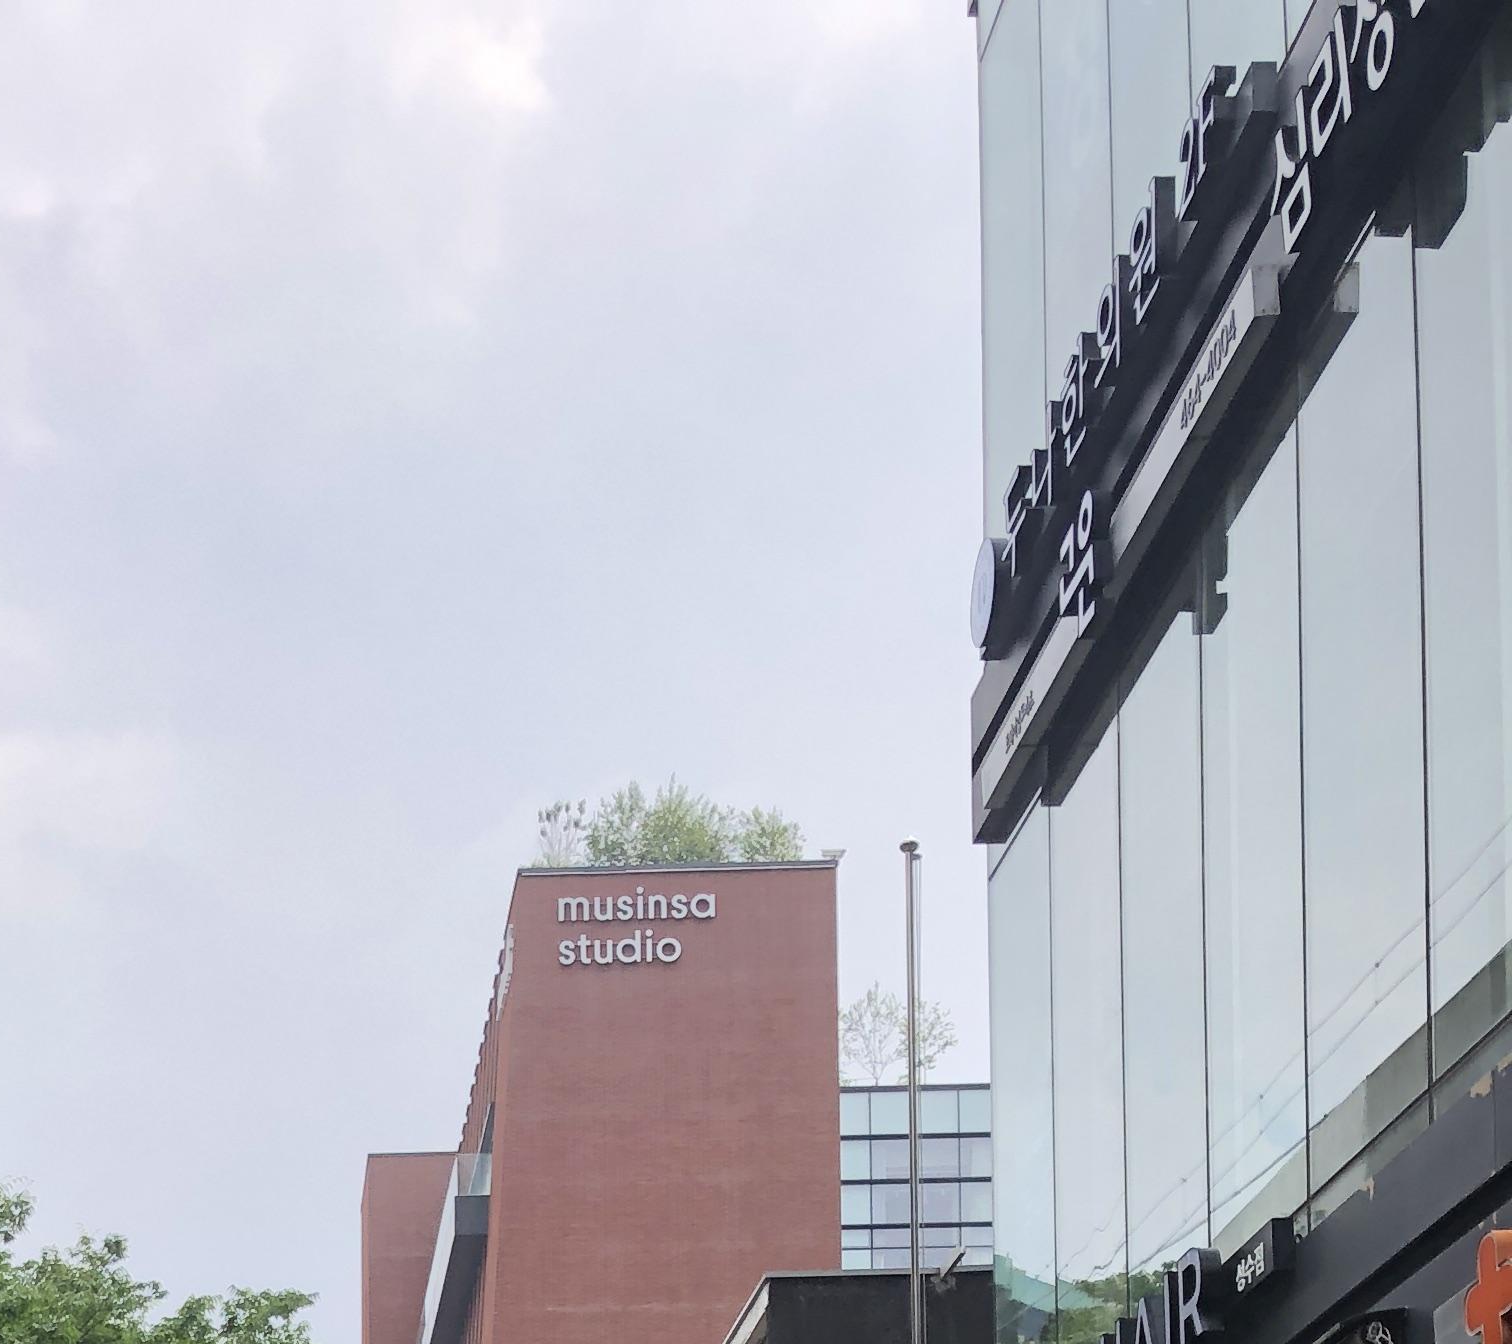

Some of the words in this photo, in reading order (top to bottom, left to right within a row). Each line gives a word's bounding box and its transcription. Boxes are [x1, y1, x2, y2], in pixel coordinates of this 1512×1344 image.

[1001, 176, 1161, 578] 두나한의원
[1174, 65, 1216, 222] 2F
[1180, 308, 1237, 430] 464-4004
[557, 886, 716, 922] musinsa
[557, 929, 682, 966] studio
[1235, 1242, 1265, 1293] 성수점
